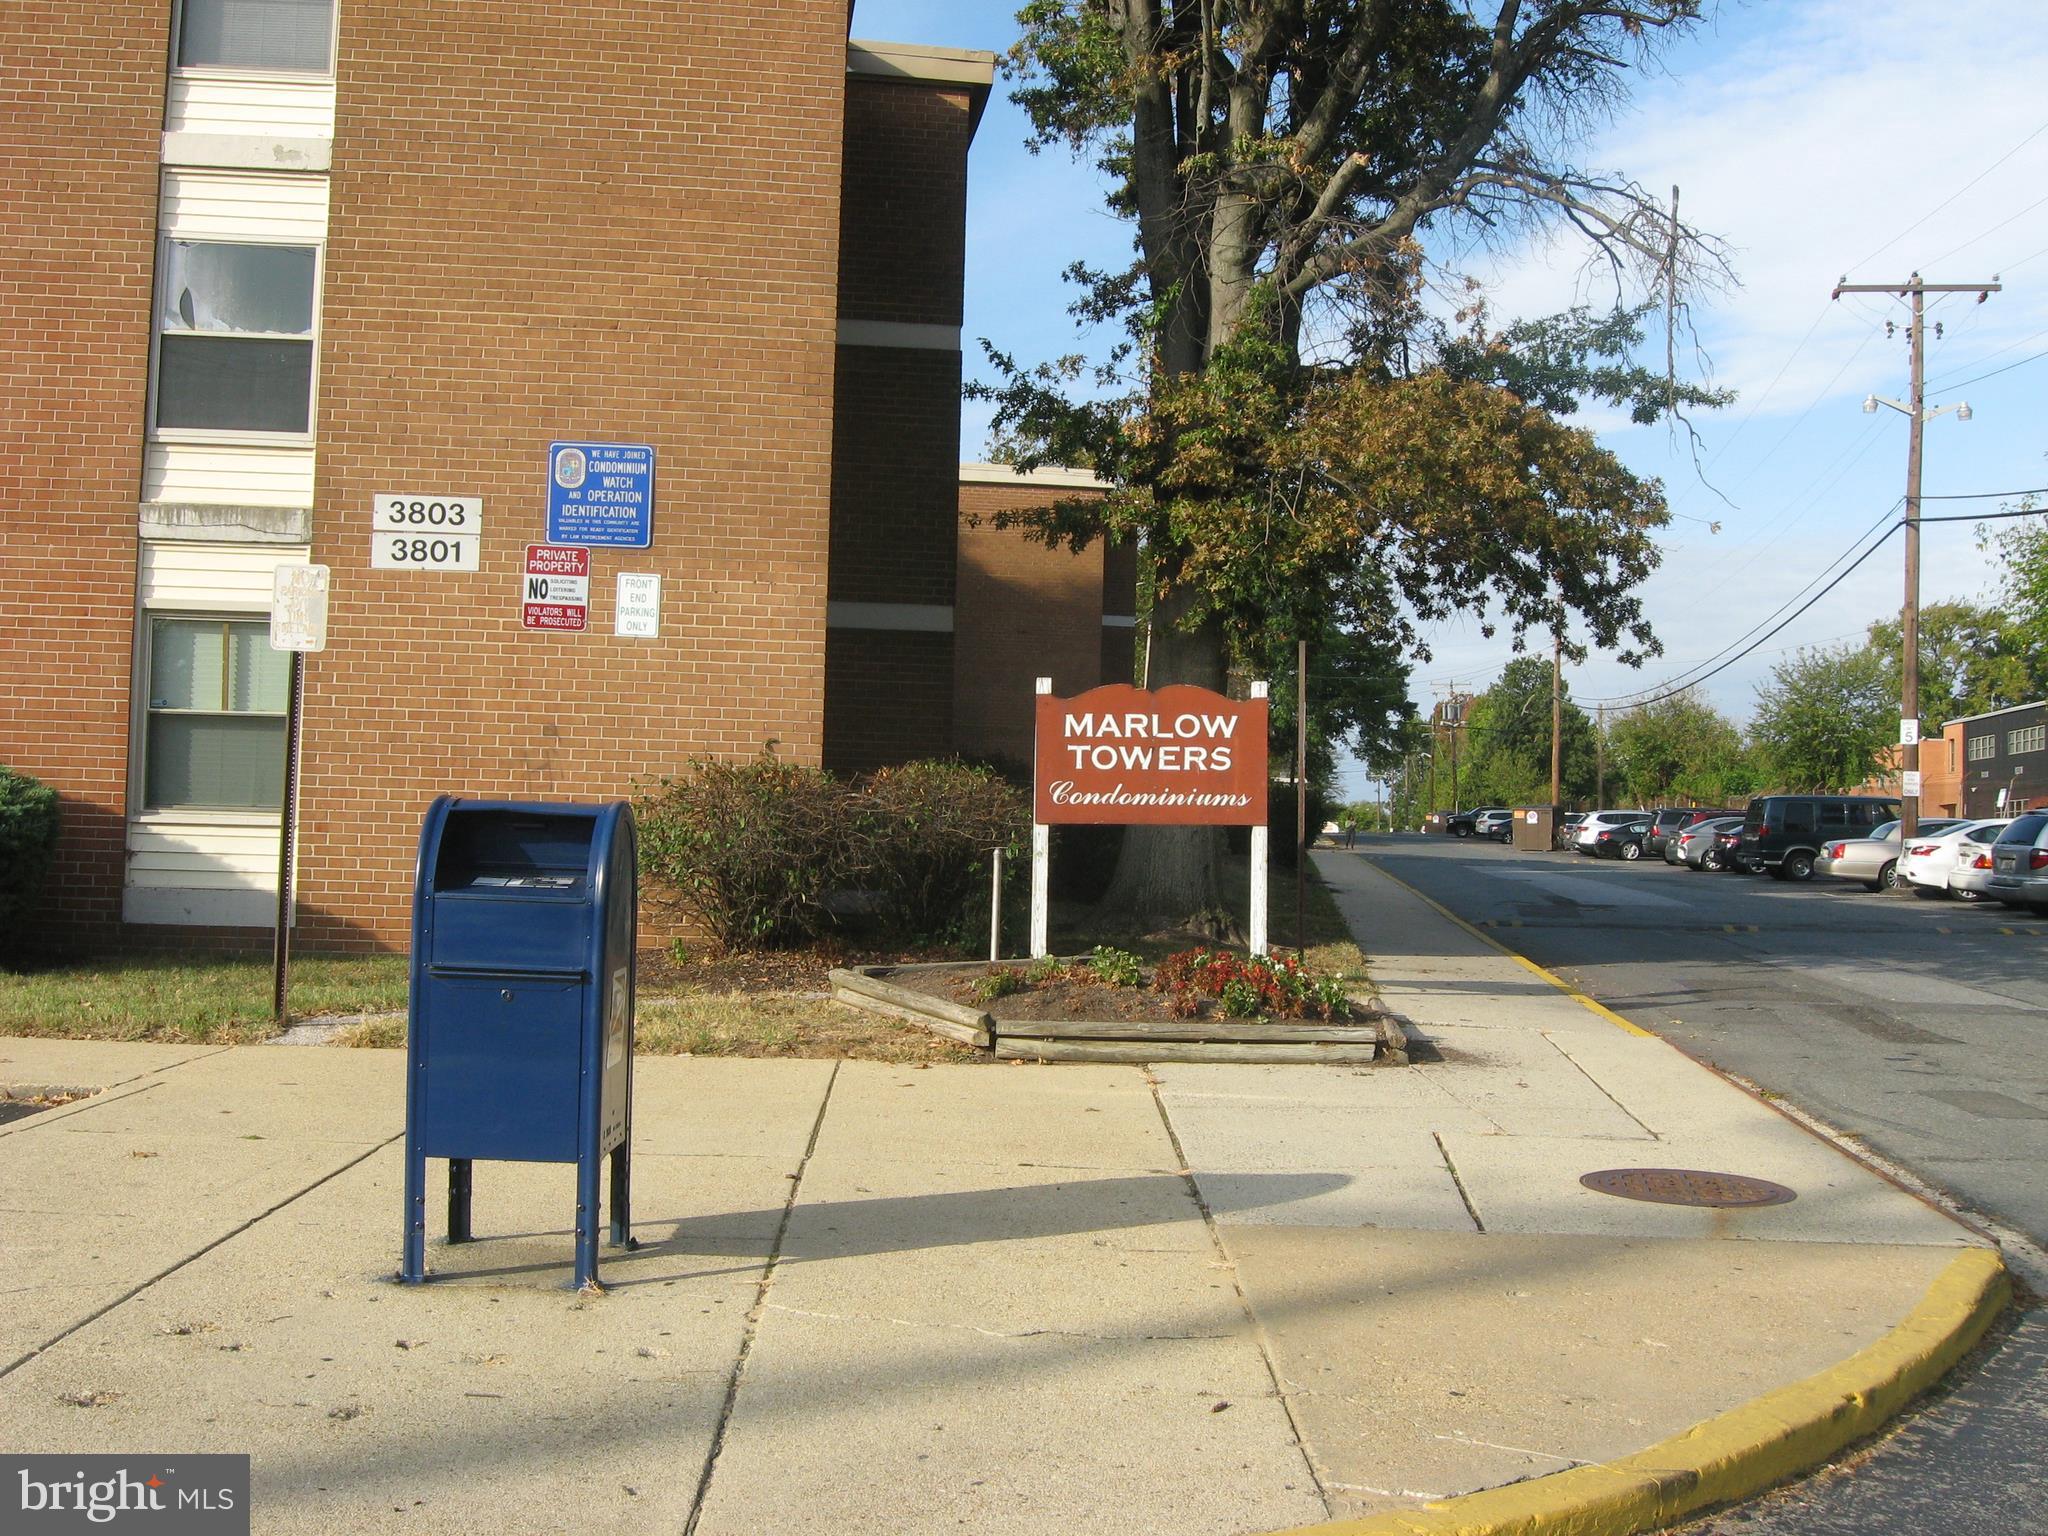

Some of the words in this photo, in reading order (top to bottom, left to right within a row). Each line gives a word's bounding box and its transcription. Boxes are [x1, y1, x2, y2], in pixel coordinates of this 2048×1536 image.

[604, 450, 620, 458] HAVE
[623, 451, 646, 459] JOINED
[588, 461, 646, 474] CONDOMINIUM
[602, 477, 633, 489] WATCH
[568, 491, 582, 499] AND
[587, 491, 642, 503] OPERATION
[388, 501, 465, 526] 3803
[562, 504, 636, 518] IDENTIFICATION
[391, 539, 461, 562] 3801
[536, 549, 579, 562] PRIVATE
[529, 560, 584, 573] PROPERTY
[528, 578, 548, 600] NO
[625, 578, 653, 589] FRONT
[630, 593, 647, 603] END
[528, 606, 562, 616] VIOLATORS
[567, 609, 582, 618] WILL
[620, 607, 655, 618] PARKING
[527, 616, 535, 625] BE
[540, 617, 582, 627] PROSECUTED
[626, 621, 648, 631] ONLY
[1064, 713, 1238, 739] MARLOW
[1905, 732, 1913, 742] 5
[1067, 744, 1232, 771] TOWERS
[1049, 780, 1252, 807] Condominiums
